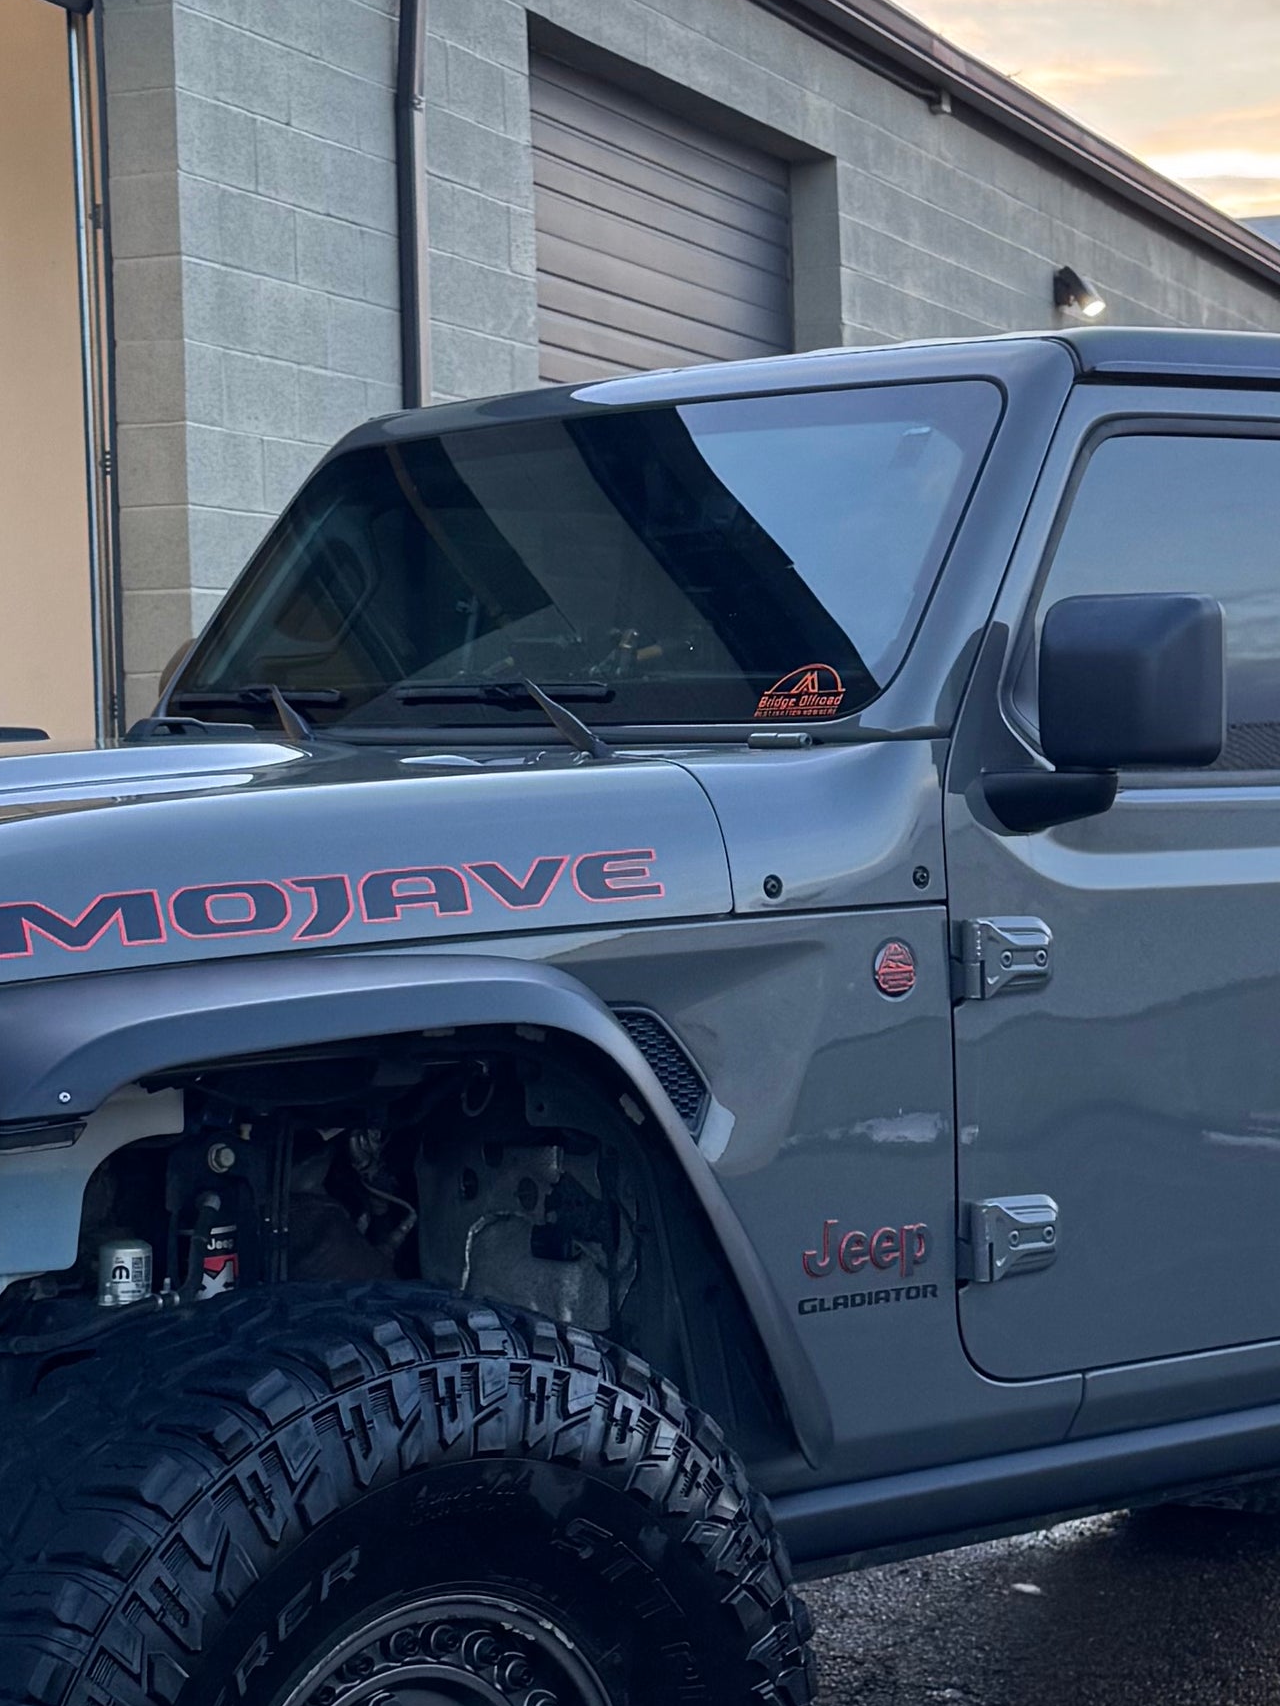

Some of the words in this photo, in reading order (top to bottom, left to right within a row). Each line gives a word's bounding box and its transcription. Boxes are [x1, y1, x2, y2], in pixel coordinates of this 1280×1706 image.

[758, 695, 796, 709] Bridge
[799, 693, 844, 707] Offroad
[803, 1219, 934, 1278] Jeep
[798, 1284, 938, 1315] GLADIATOR
